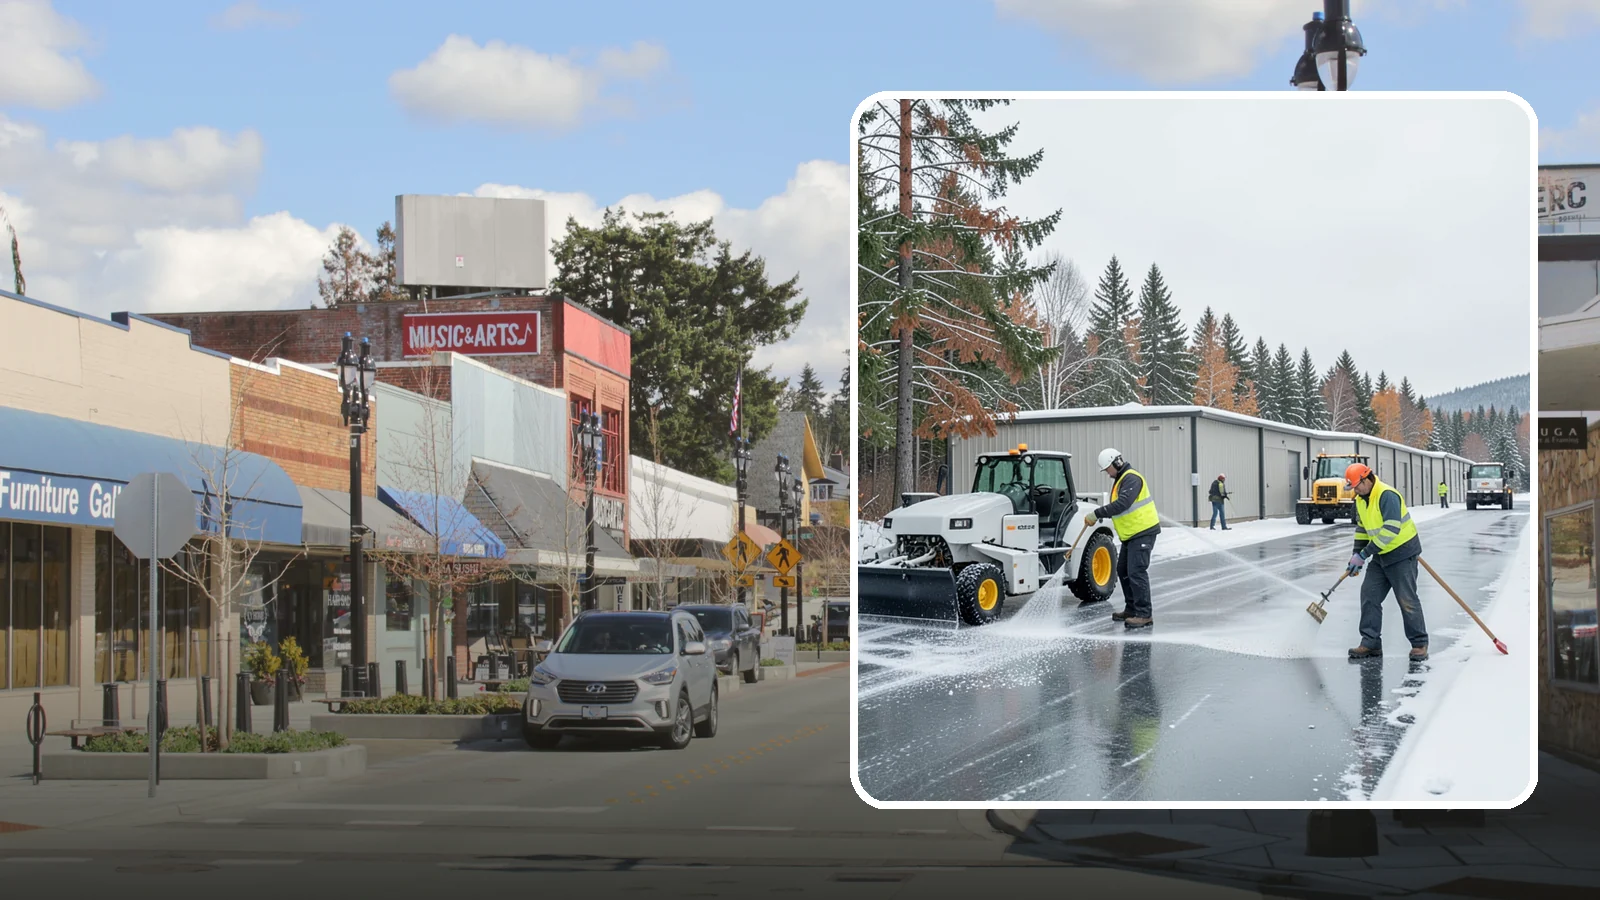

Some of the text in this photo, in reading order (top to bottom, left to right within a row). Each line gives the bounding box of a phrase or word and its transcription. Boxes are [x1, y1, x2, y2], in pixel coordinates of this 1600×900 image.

[408, 323, 519, 349] MUSIC&ARTS
[1540, 427, 1577, 437] UGA
[0, 471, 122, 519] Furniture Gal
[453, 563, 480, 574] SUSHI
